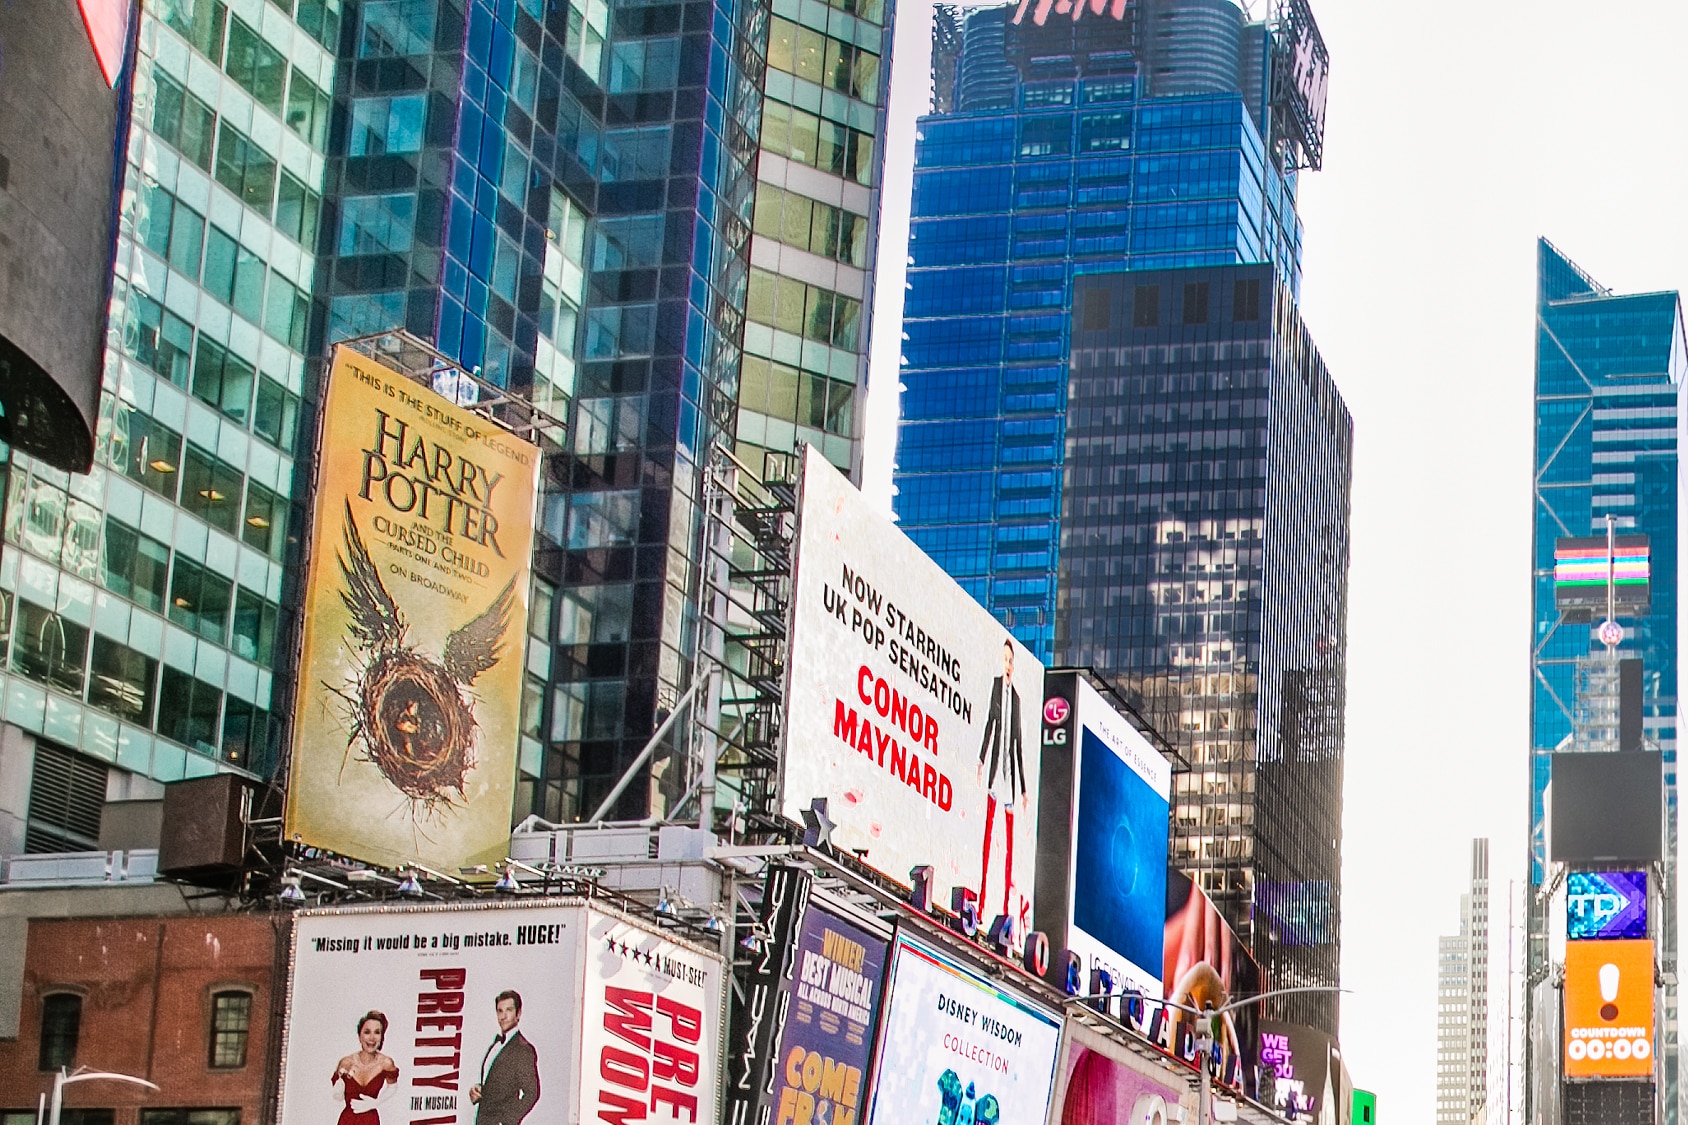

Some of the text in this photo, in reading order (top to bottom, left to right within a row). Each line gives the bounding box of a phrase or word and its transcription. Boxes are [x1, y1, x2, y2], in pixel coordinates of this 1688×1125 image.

[383, 385, 482, 441] IS THE STUFF OF
[375, 408, 505, 511] HARRY
[358, 448, 506, 560] POTTER
[372, 516, 490, 578] CURSED CHILD
[412, 522, 454, 546] AND THE
[388, 541, 472, 584] PARTS ONE AND TWO
[390, 563, 469, 604] ON BROADWAY
[841, 561, 962, 684] NOW STARRING
[823, 583, 972, 725] UK POP SENSATION
[858, 665, 940, 757] CONOR
[833, 697, 953, 813] MAYNARD
[1043, 729, 1067, 746] LG
[363, 924, 566, 951] it would be a big mistake. HUGE!"
[797, 982, 809, 1000] ALL
[801, 950, 873, 1010] BEST MUSICAL
[411, 967, 466, 1092] PRETTY
[938, 993, 1022, 1049] DISNEY WISDOM
[1262, 1033, 1289, 1050] WE
[1571, 1027, 1646, 1039] COUNTDOWN
[785, 1045, 861, 1101] COME
[943, 1033, 1009, 1075] COLLECTION
[1261, 1048, 1292, 1068] GET
[1568, 1039, 1650, 1060] 00:00
[410, 1095, 458, 1111] THE MUSICAL
